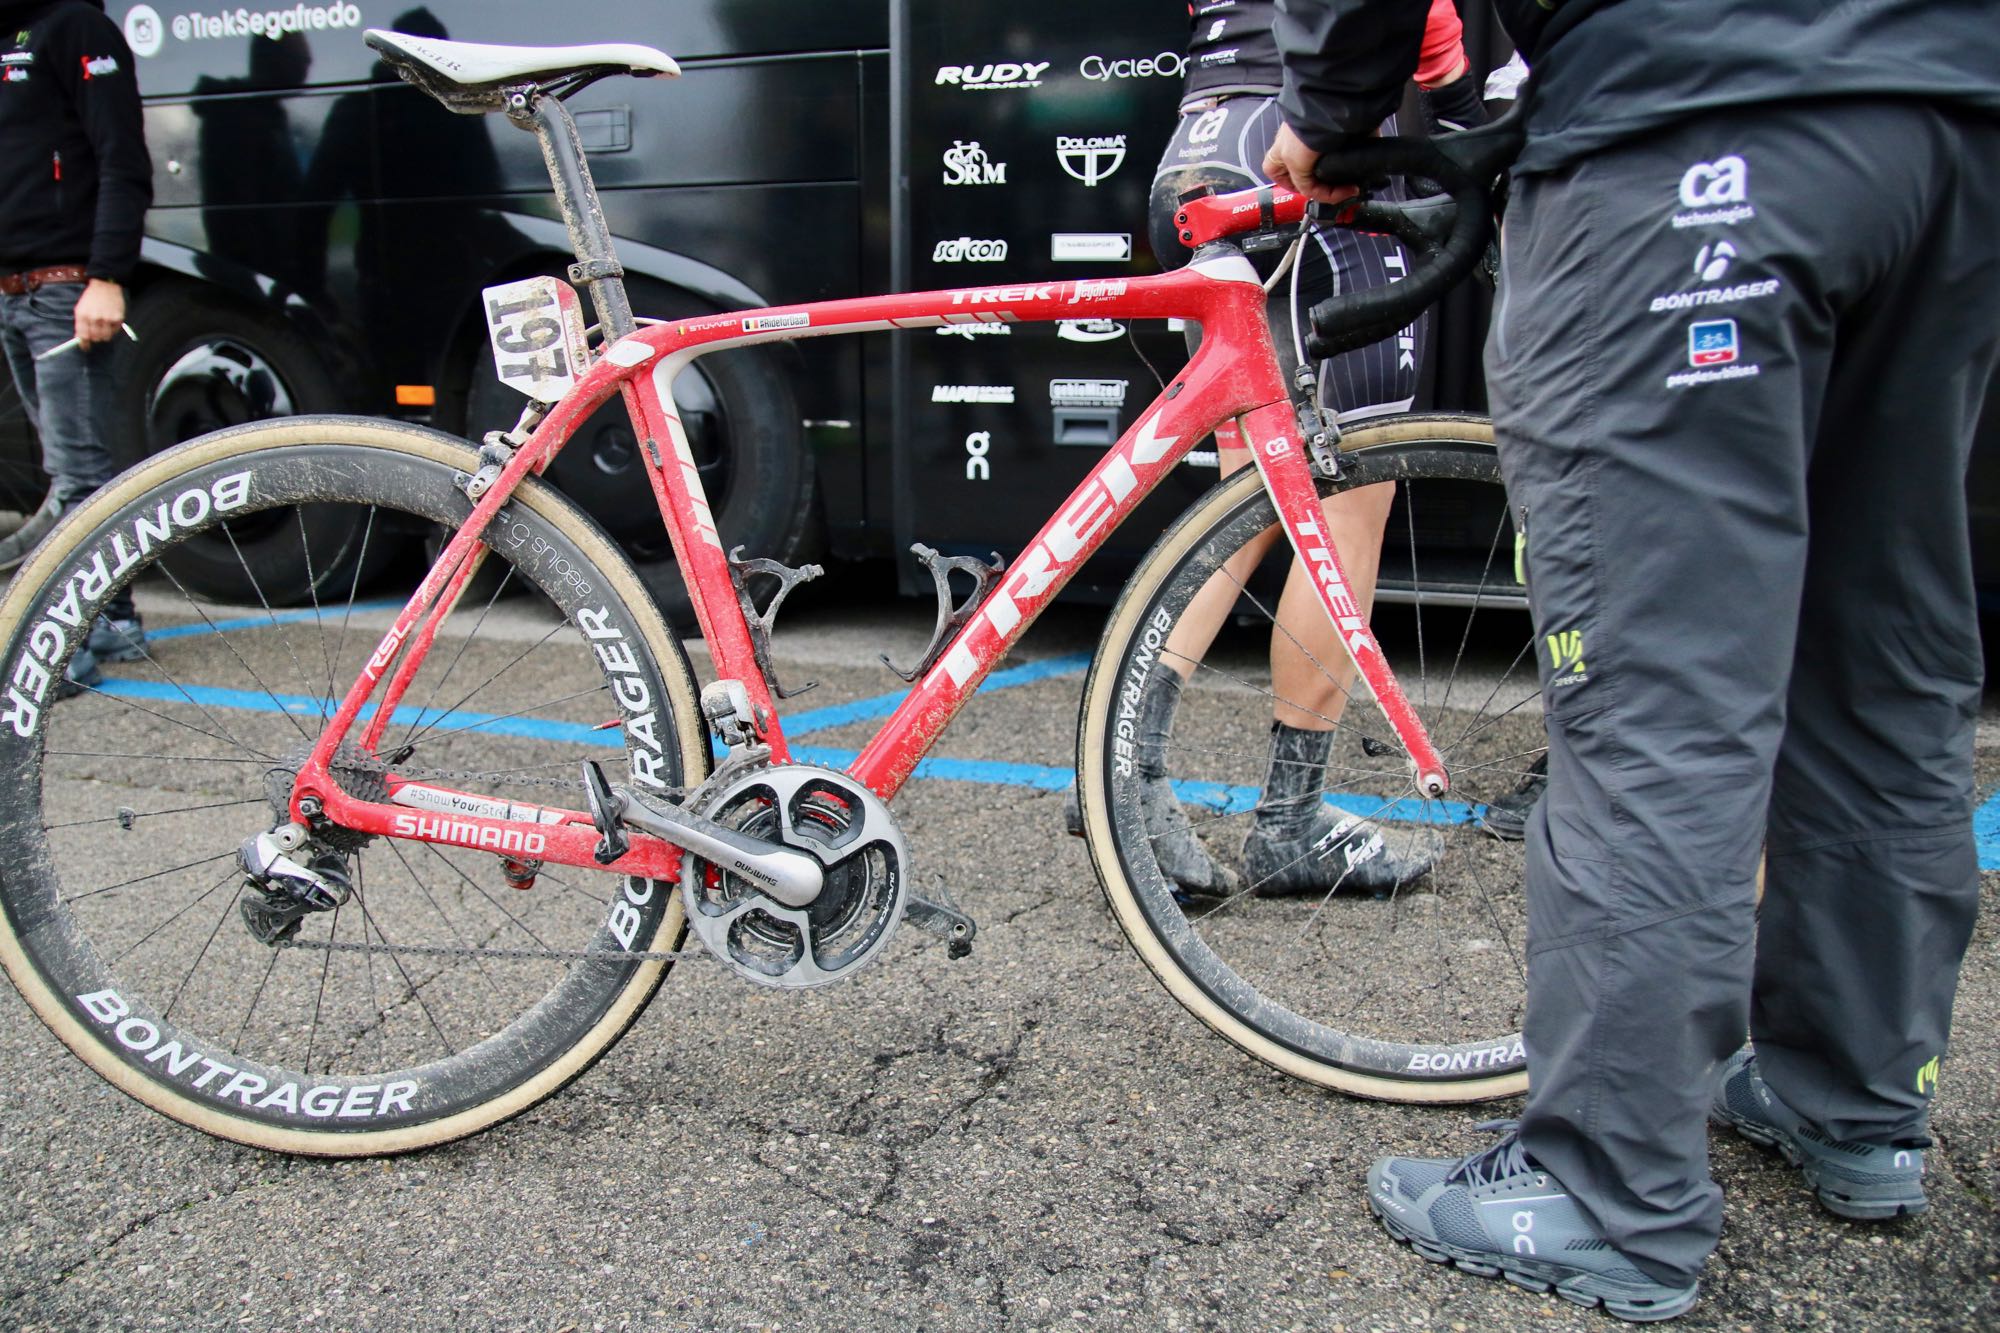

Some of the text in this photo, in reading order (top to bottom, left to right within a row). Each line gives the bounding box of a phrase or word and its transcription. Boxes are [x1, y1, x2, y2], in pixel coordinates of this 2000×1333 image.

[172, 1, 361, 41] @TrekSegafredo
[934, 61, 1050, 85] RUDY
[961, 80, 1043, 90] PROJECT
[943, 147, 1007, 185] SRM
[1679, 155, 1746, 208] ca
[947, 280, 1128, 305] TREK Segafredo
[1650, 279, 1780, 312] BONTRAGER
[488, 288, 569, 382] 197
[689, 318, 738, 333] STUYVEN
[531, 536, 592, 598] aeolus
[922, 407, 1182, 690] TREK
[2, 470, 251, 738] BONTRAGER
[1294, 509, 1376, 655] TREK
[364, 619, 414, 682] RSL
[1114, 605, 1172, 778] BONTRAGER
[394, 814, 546, 854] SHIMANO
[734, 860, 778, 887] SHIMANO
[76, 988, 418, 1118] BONTRAGER
